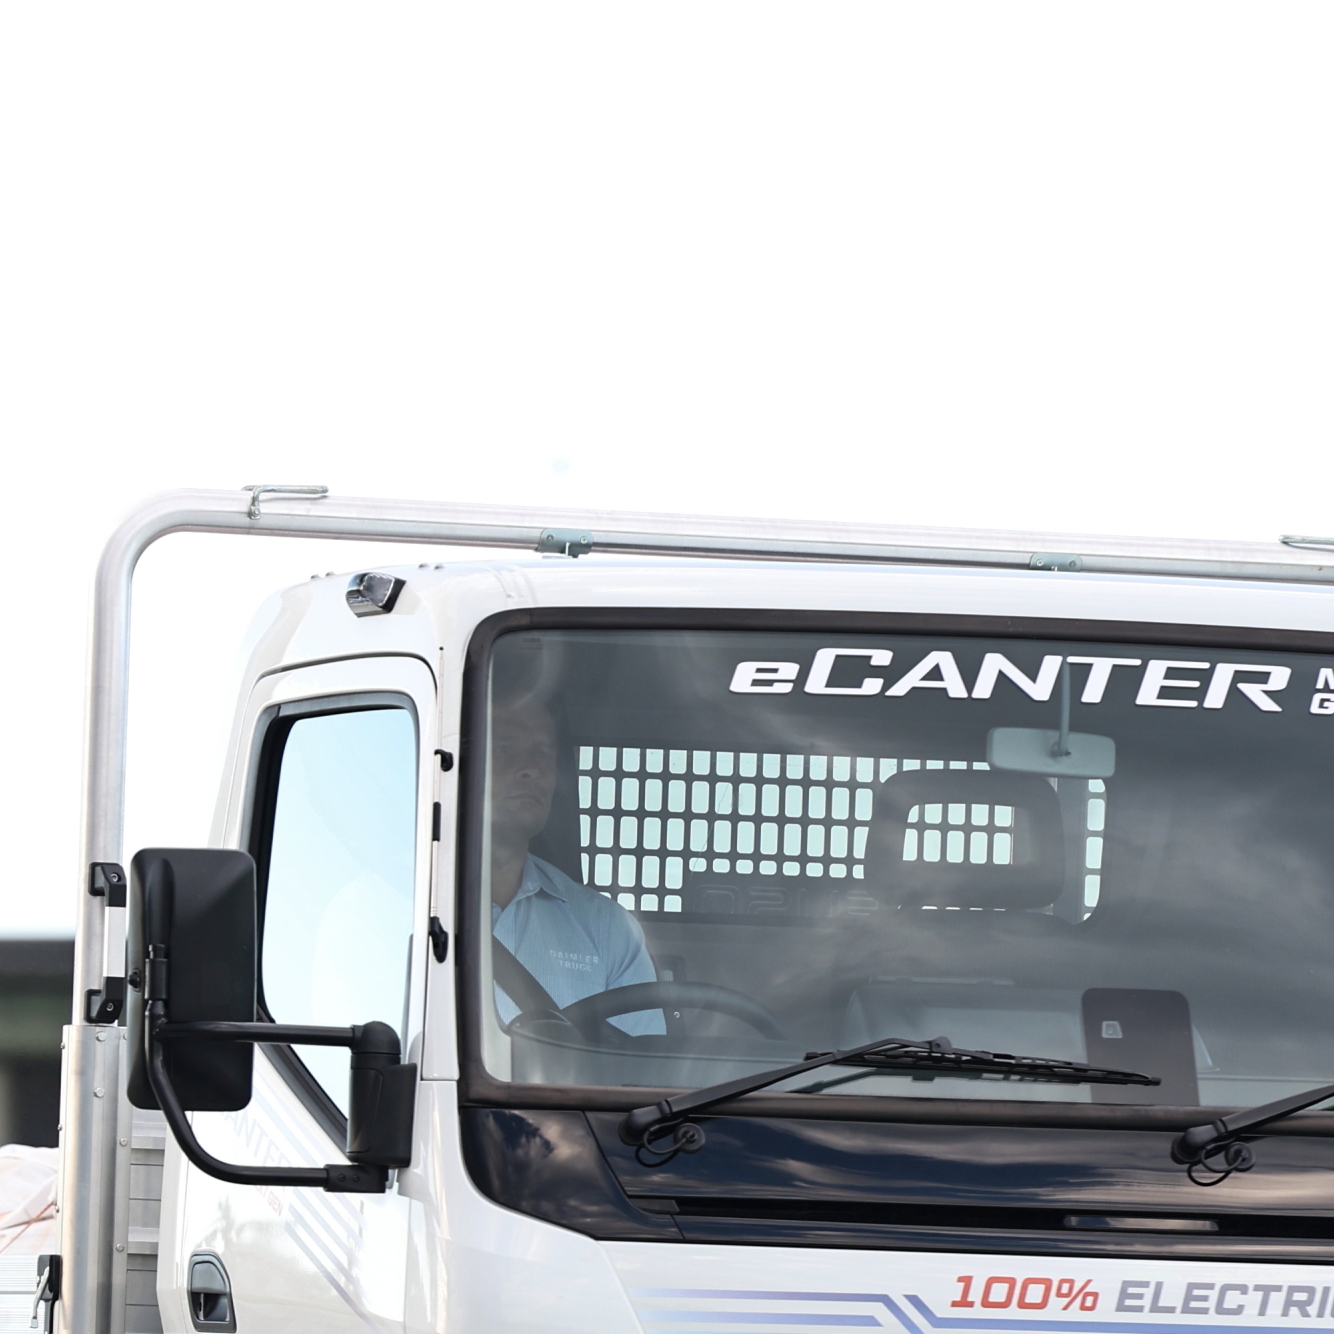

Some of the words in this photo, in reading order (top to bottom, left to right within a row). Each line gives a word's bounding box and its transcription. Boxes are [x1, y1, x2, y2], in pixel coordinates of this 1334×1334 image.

[729, 647, 1292, 712] eCANTER
[549, 949, 599, 964] DAIMLER
[559, 960, 592, 972] TRUCK
[950, 1275, 1100, 1312] 100%
